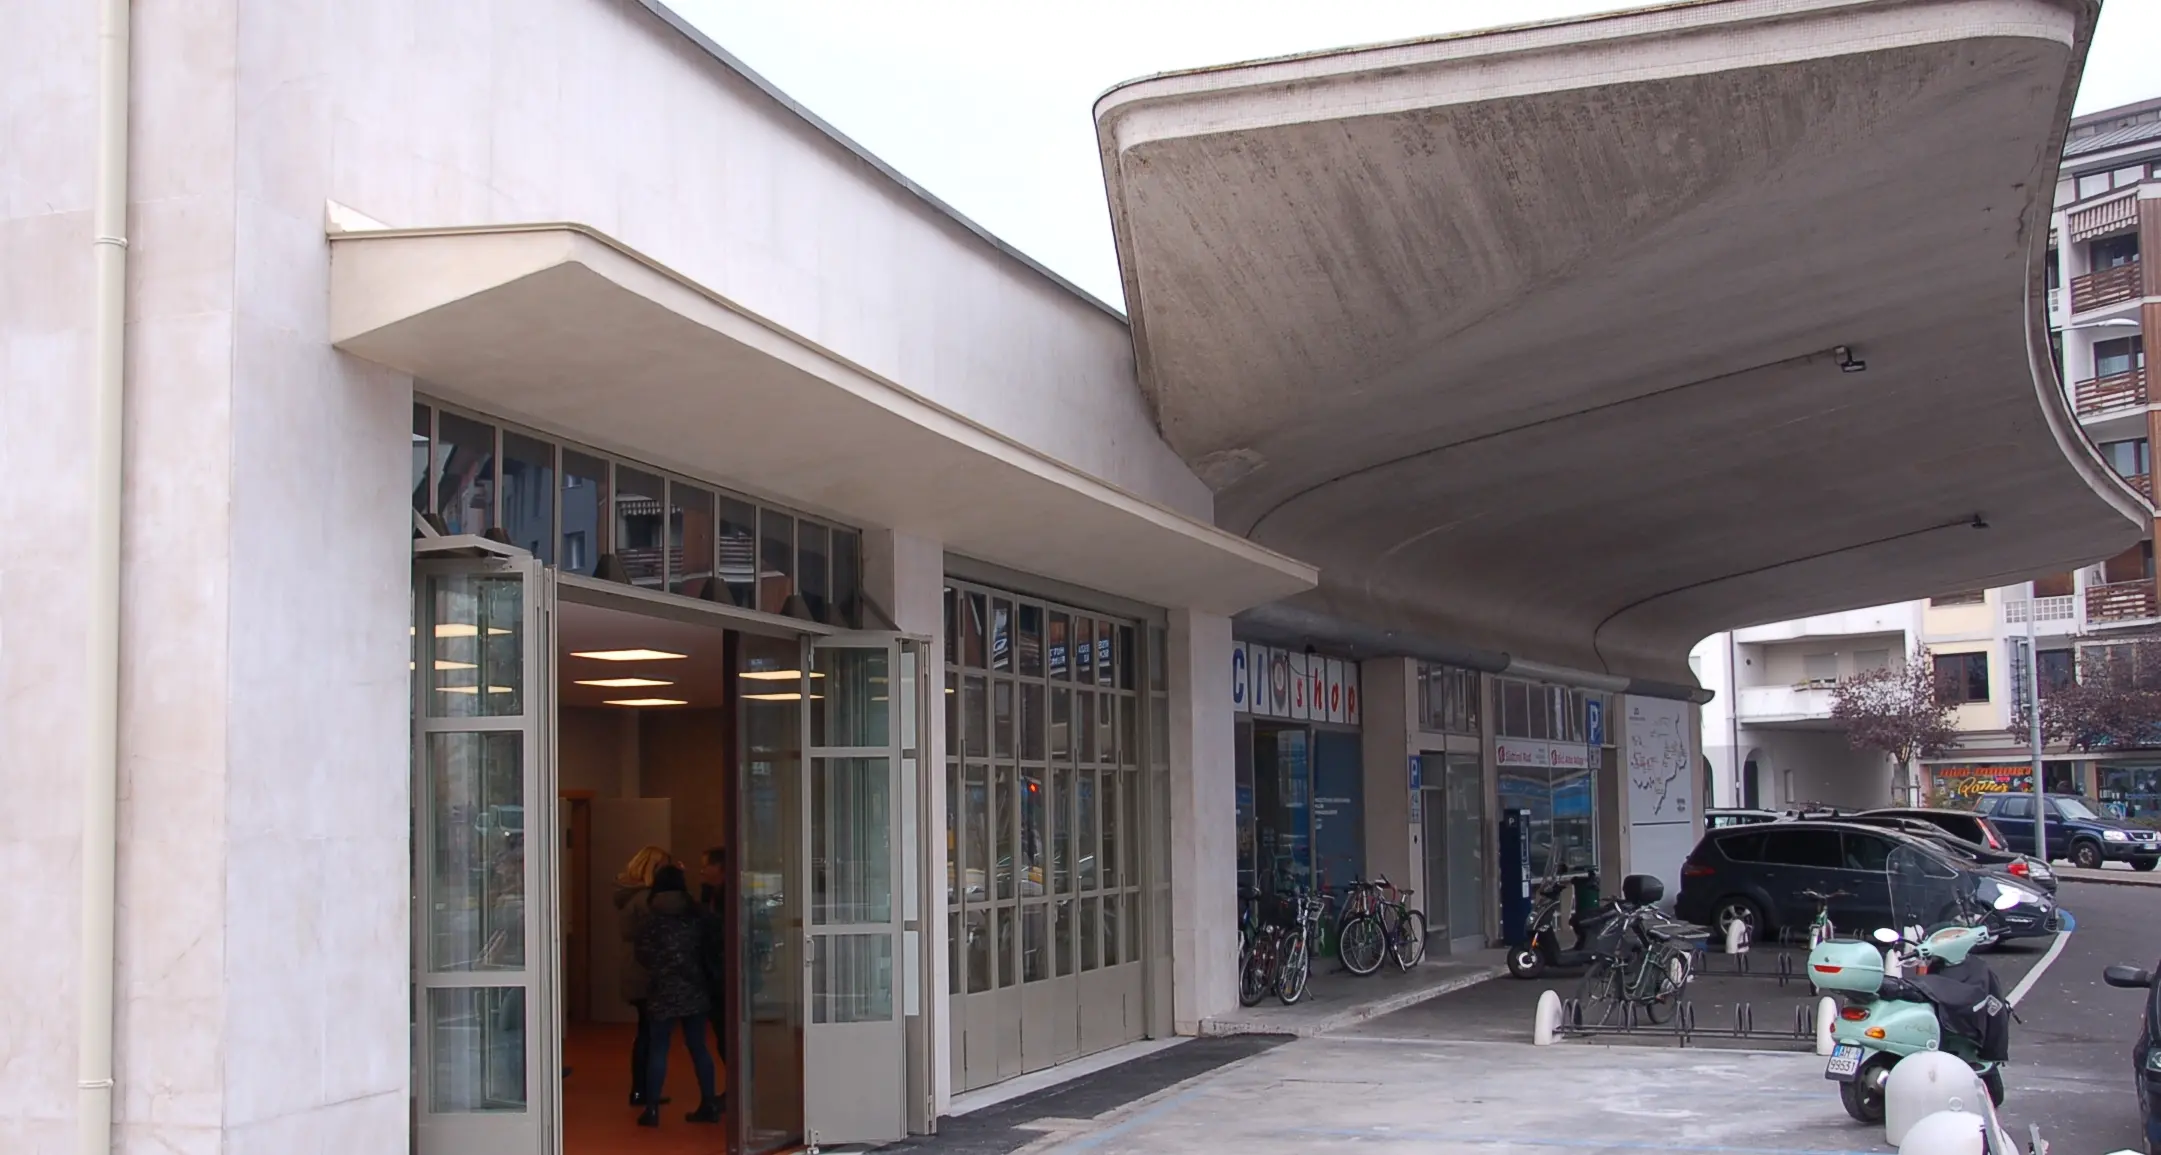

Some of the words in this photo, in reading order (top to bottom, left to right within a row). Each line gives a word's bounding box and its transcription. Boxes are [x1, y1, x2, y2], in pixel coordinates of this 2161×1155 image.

[1296, 667, 1356, 724] shop
[1590, 705, 1599, 741] P
[1411, 759, 1418, 784] P
